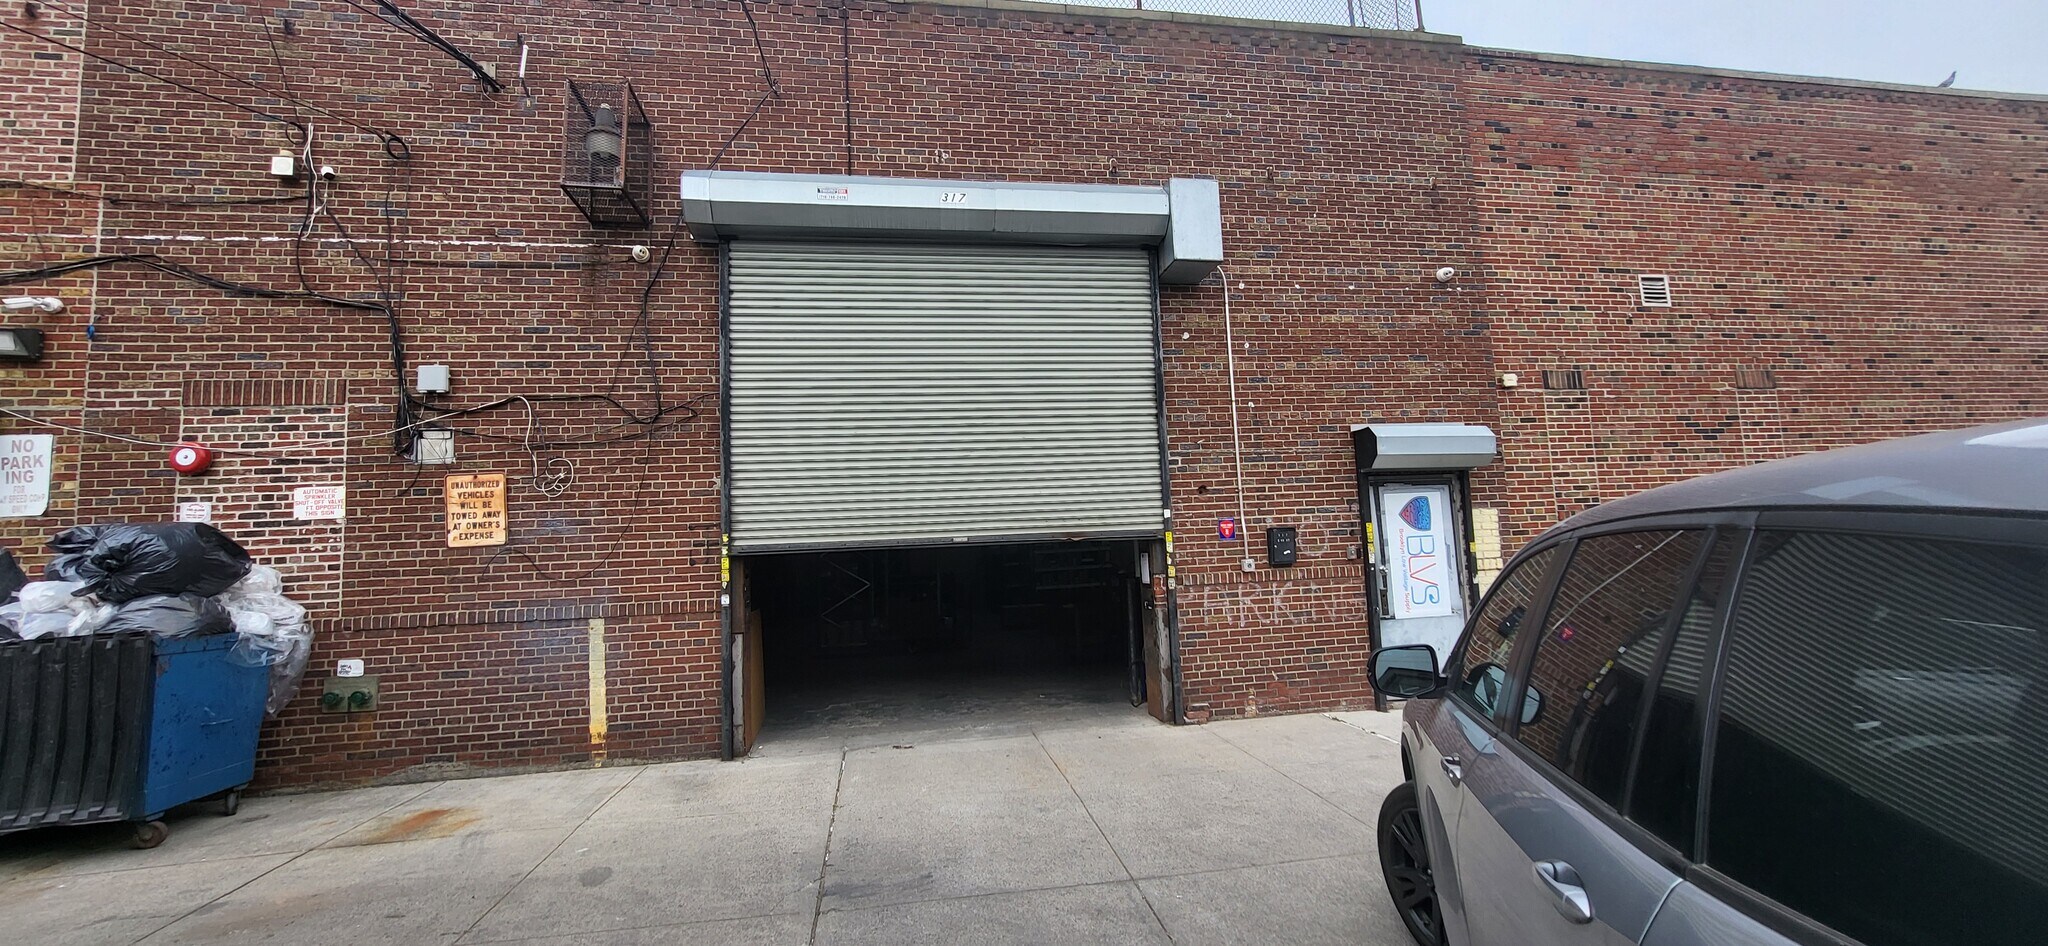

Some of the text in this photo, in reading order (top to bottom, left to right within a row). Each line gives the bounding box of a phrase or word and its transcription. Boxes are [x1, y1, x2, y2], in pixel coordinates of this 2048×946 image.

[942, 192, 966, 202] 317
[11, 439, 35, 453] NO
[1, 454, 44, 470] PARK
[6, 470, 34, 484] ING
[450, 480, 500, 489] UNAUTHORIZED
[9, 494, 28, 503] SPEED
[458, 491, 494, 499] VEHICLES
[451, 512, 477, 520] TOWED
[466, 521, 500, 529] OWNER'S
[459, 532, 494, 540] EXPENSE
[1406, 534, 1440, 604] BLVS
